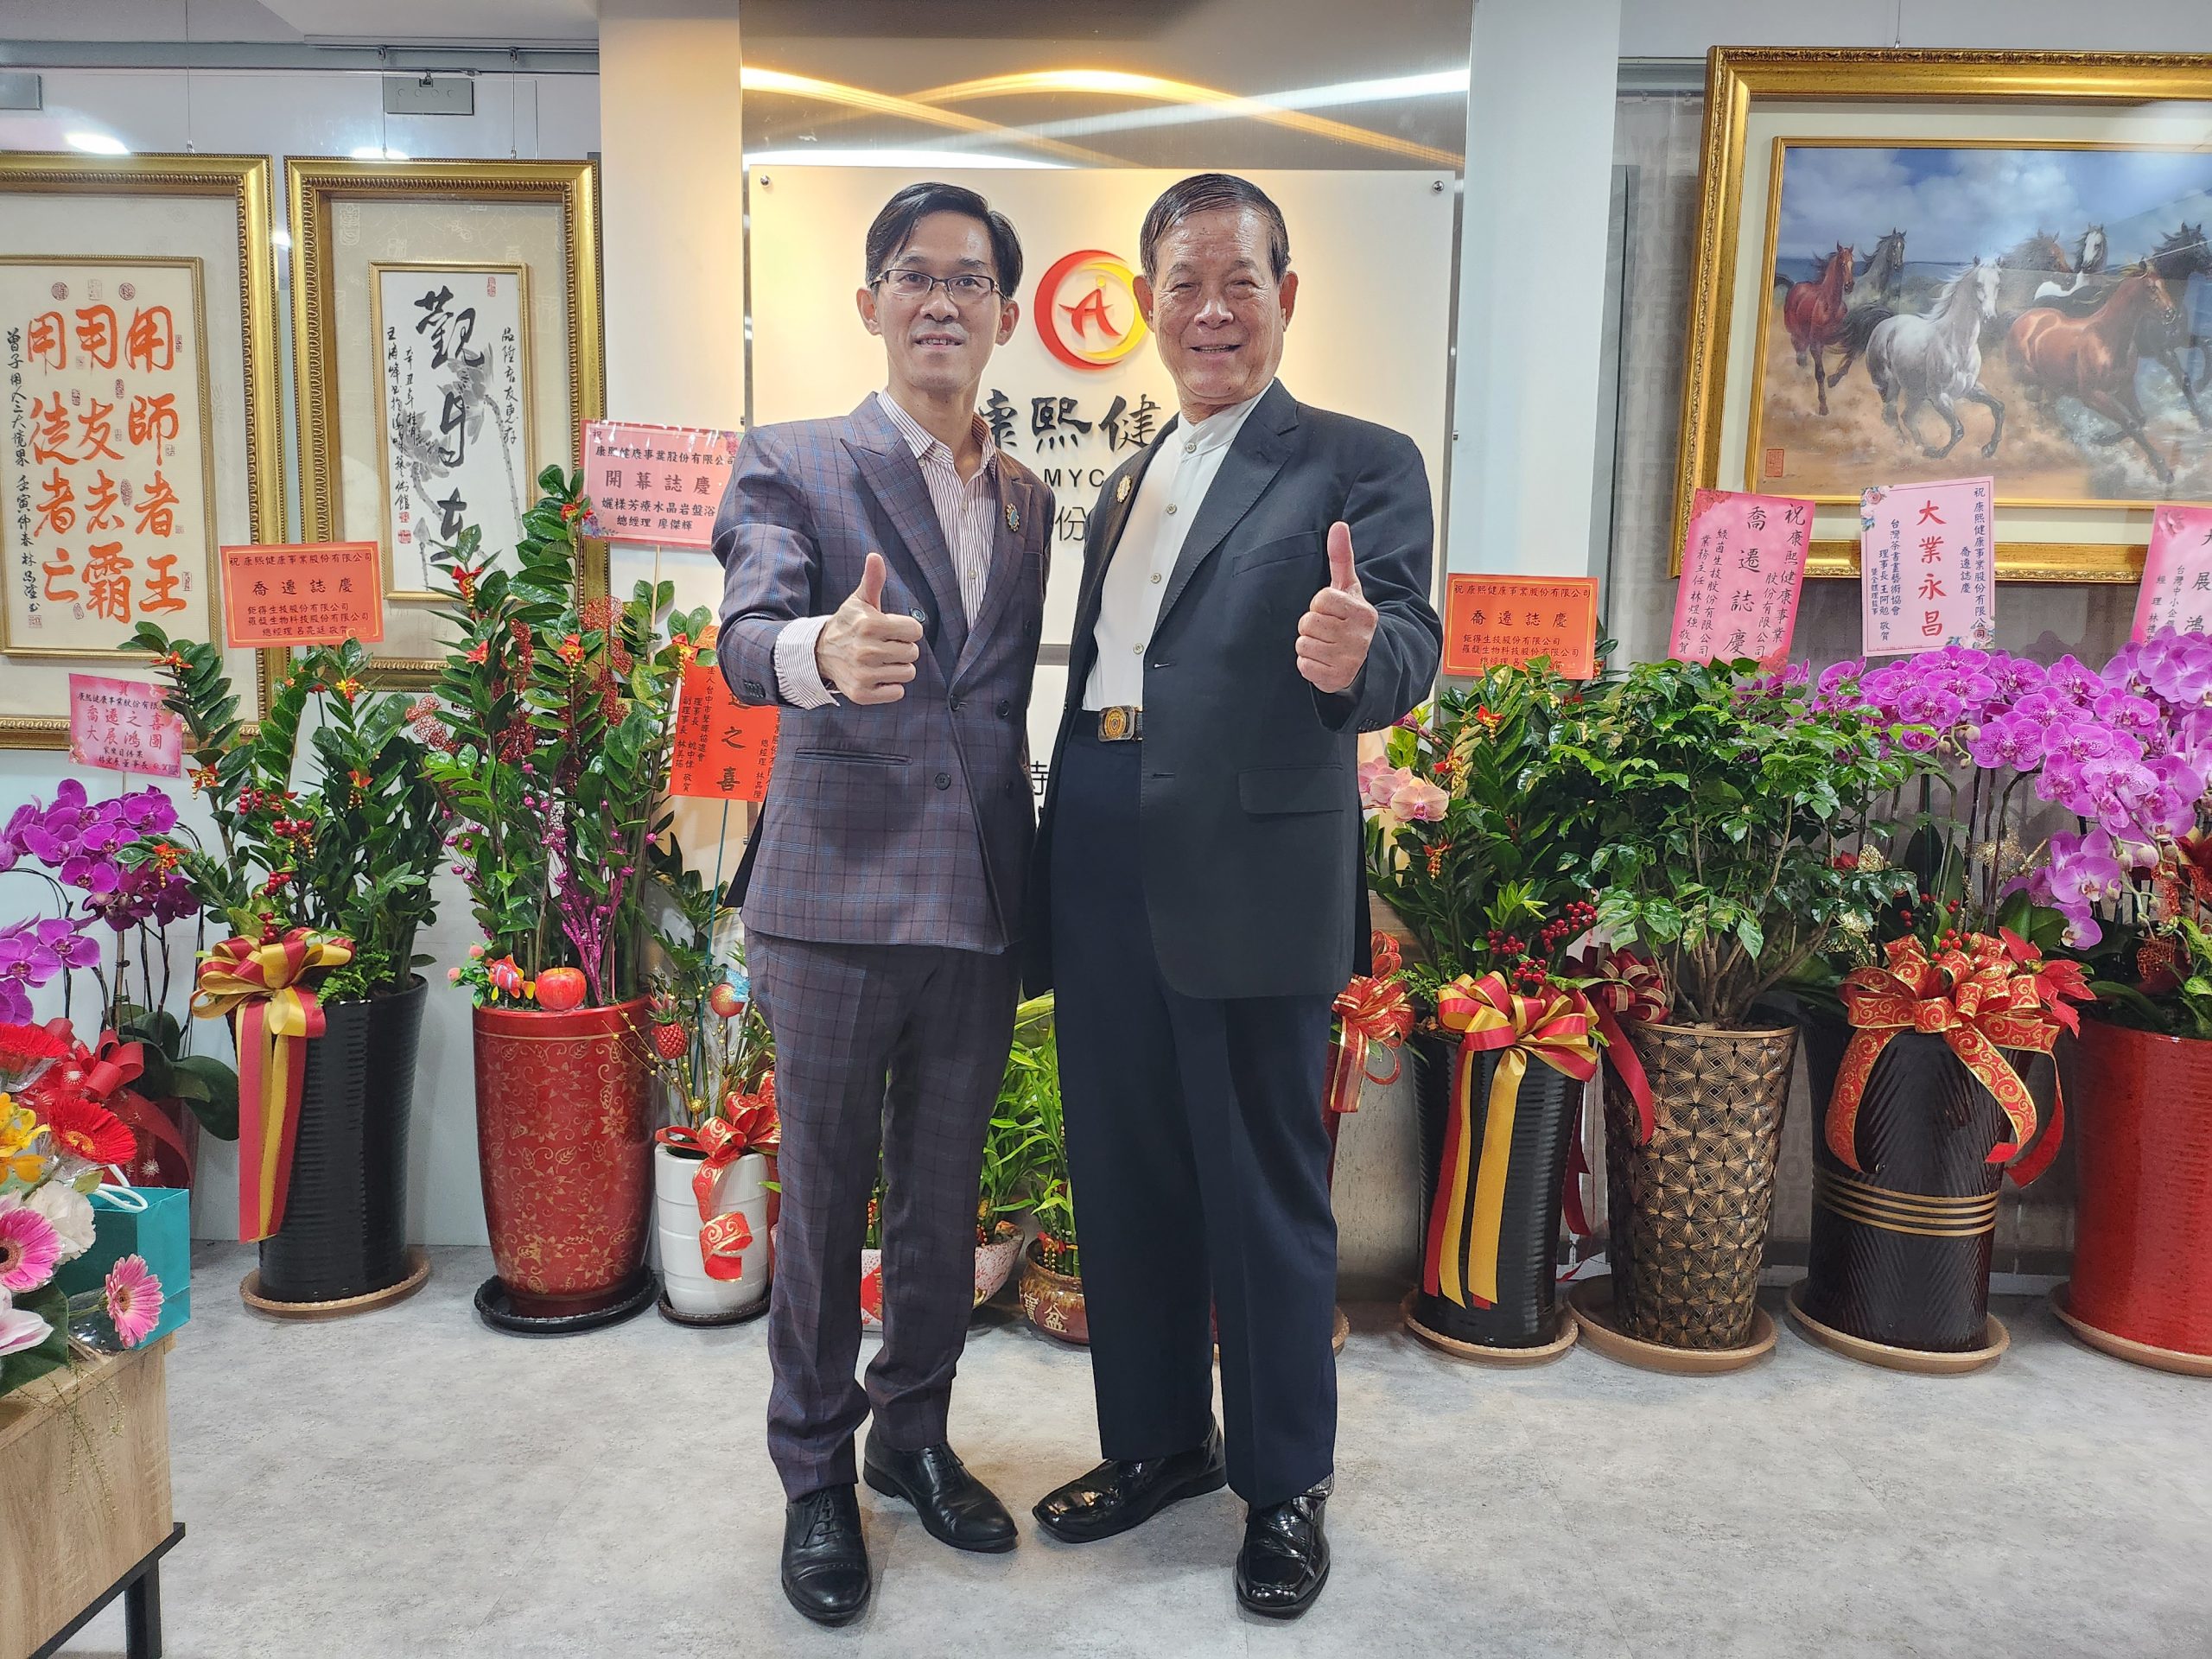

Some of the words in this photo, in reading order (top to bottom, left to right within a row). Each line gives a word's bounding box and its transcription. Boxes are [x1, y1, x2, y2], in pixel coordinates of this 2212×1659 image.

[605, 469, 711, 495] 開幕誌慶
[1044, 468, 1104, 487] MYC
[1974, 487, 1985, 498] 祝
[616, 515, 652, 527] 總經理
[1055, 505, 1086, 542] 份
[244, 552, 372, 566] 康熙健康事業股份有限公司
[1916, 499, 1948, 637] 大業永昌
[1960, 546, 1972, 594] 喬遷誌慶
[1974, 501, 1986, 639] 康熙健康事業股份有限公司
[252, 577, 353, 595] 喬遷誌慶
[1466, 584, 1592, 599] 康熙健康事業股份有限公司
[1723, 506, 1767, 656] 喬遷誌慶
[1471, 609, 1567, 628] 喬遷誌慶
[1754, 572, 1779, 658] 股份有限公司
[87, 704, 164, 731] 喬遷之喜
[86, 725, 162, 750] 大展鴻圖
